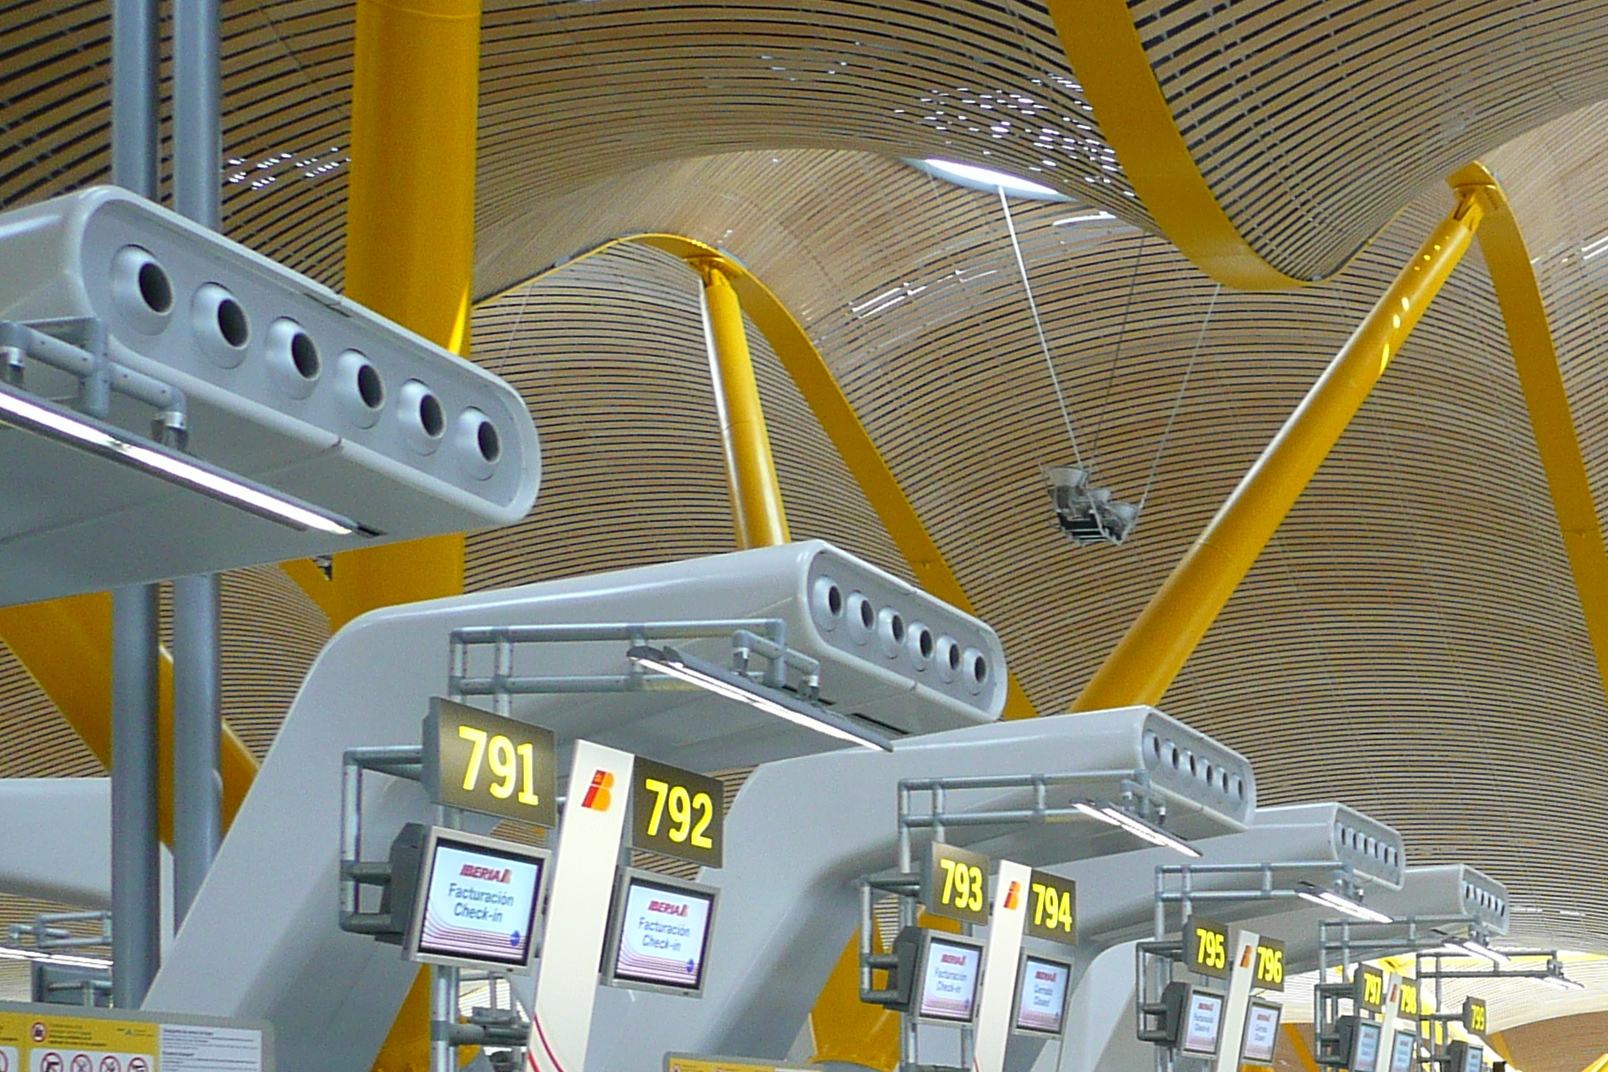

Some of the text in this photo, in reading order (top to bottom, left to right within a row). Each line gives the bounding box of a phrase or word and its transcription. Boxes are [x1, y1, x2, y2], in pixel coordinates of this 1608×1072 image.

[459, 725, 540, 806] 791
[645, 778, 713, 849] 792
[459, 863, 503, 883] IBERIA
[940, 858, 983, 912] 793
[448, 882, 514, 907] Facturación
[647, 899, 681, 917] IBERIA
[1032, 883, 1072, 933] 794
[453, 902, 503, 923] Check-in
[638, 916, 690, 938] Facturación
[642, 934, 682, 952] Check-in
[1196, 927, 1226, 970] 795
[1257, 946, 1283, 984] 796
[1363, 973, 1382, 1005] 797
[1400, 984, 1417, 1015] 798
